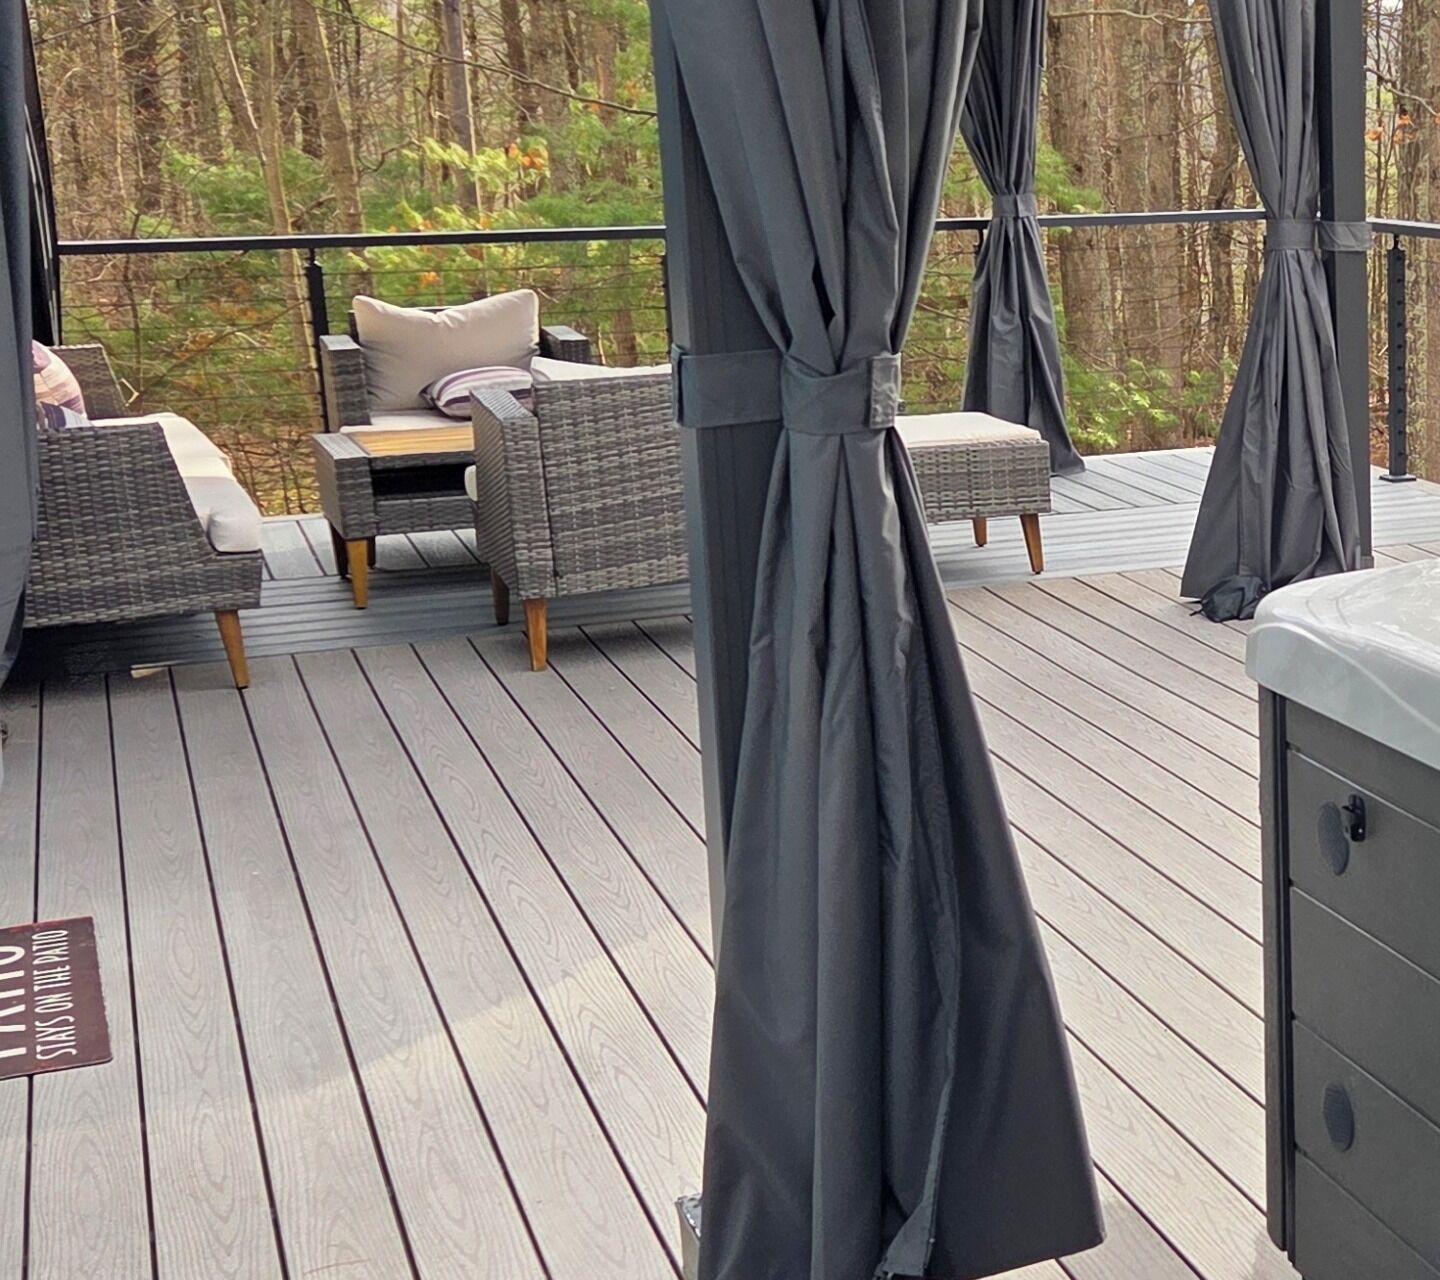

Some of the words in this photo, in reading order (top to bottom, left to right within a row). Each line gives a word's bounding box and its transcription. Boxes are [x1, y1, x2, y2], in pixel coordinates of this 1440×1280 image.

[31, 930, 70, 965] PATIO
[33, 965, 72, 992] THE
[34, 992, 74, 1013] ON
[35, 1015, 78, 1060] STAYS
